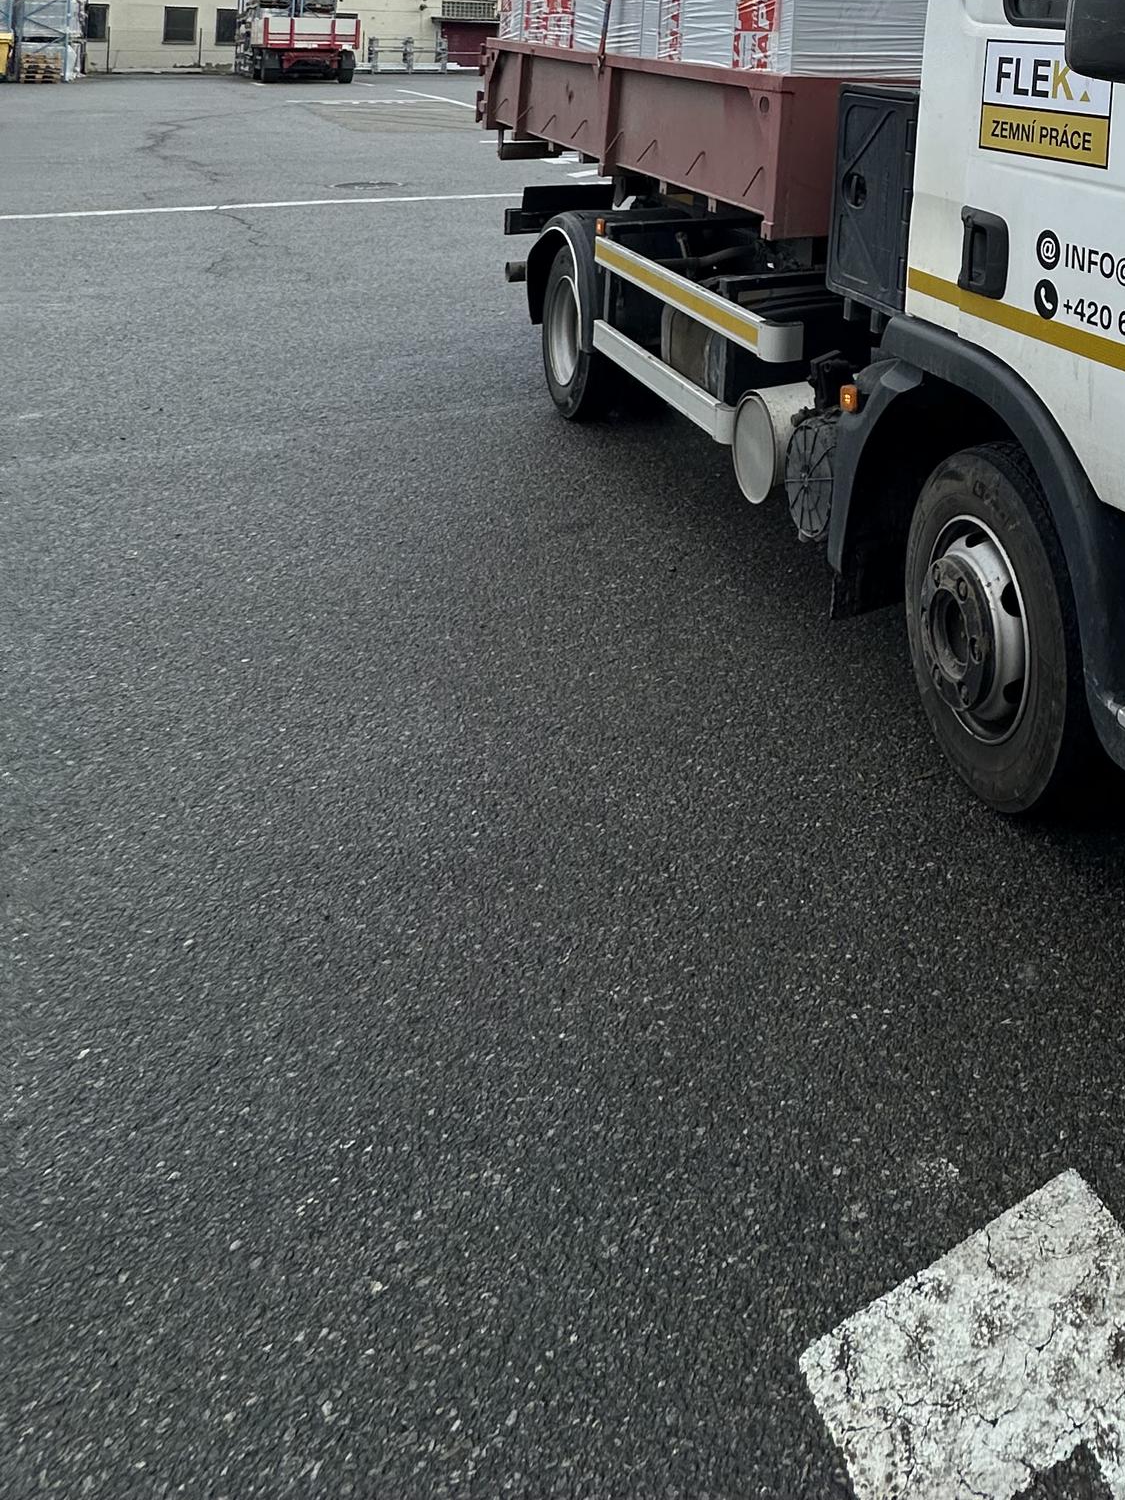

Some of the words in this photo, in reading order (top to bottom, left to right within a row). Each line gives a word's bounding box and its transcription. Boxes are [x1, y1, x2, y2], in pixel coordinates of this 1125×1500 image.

[995, 56, 1074, 101] FLEK
[990, 119, 1037, 143] ZEMNÍ
[1039, 123, 1092, 152] PRÁCE
[1063, 298, 1112, 331] +420
